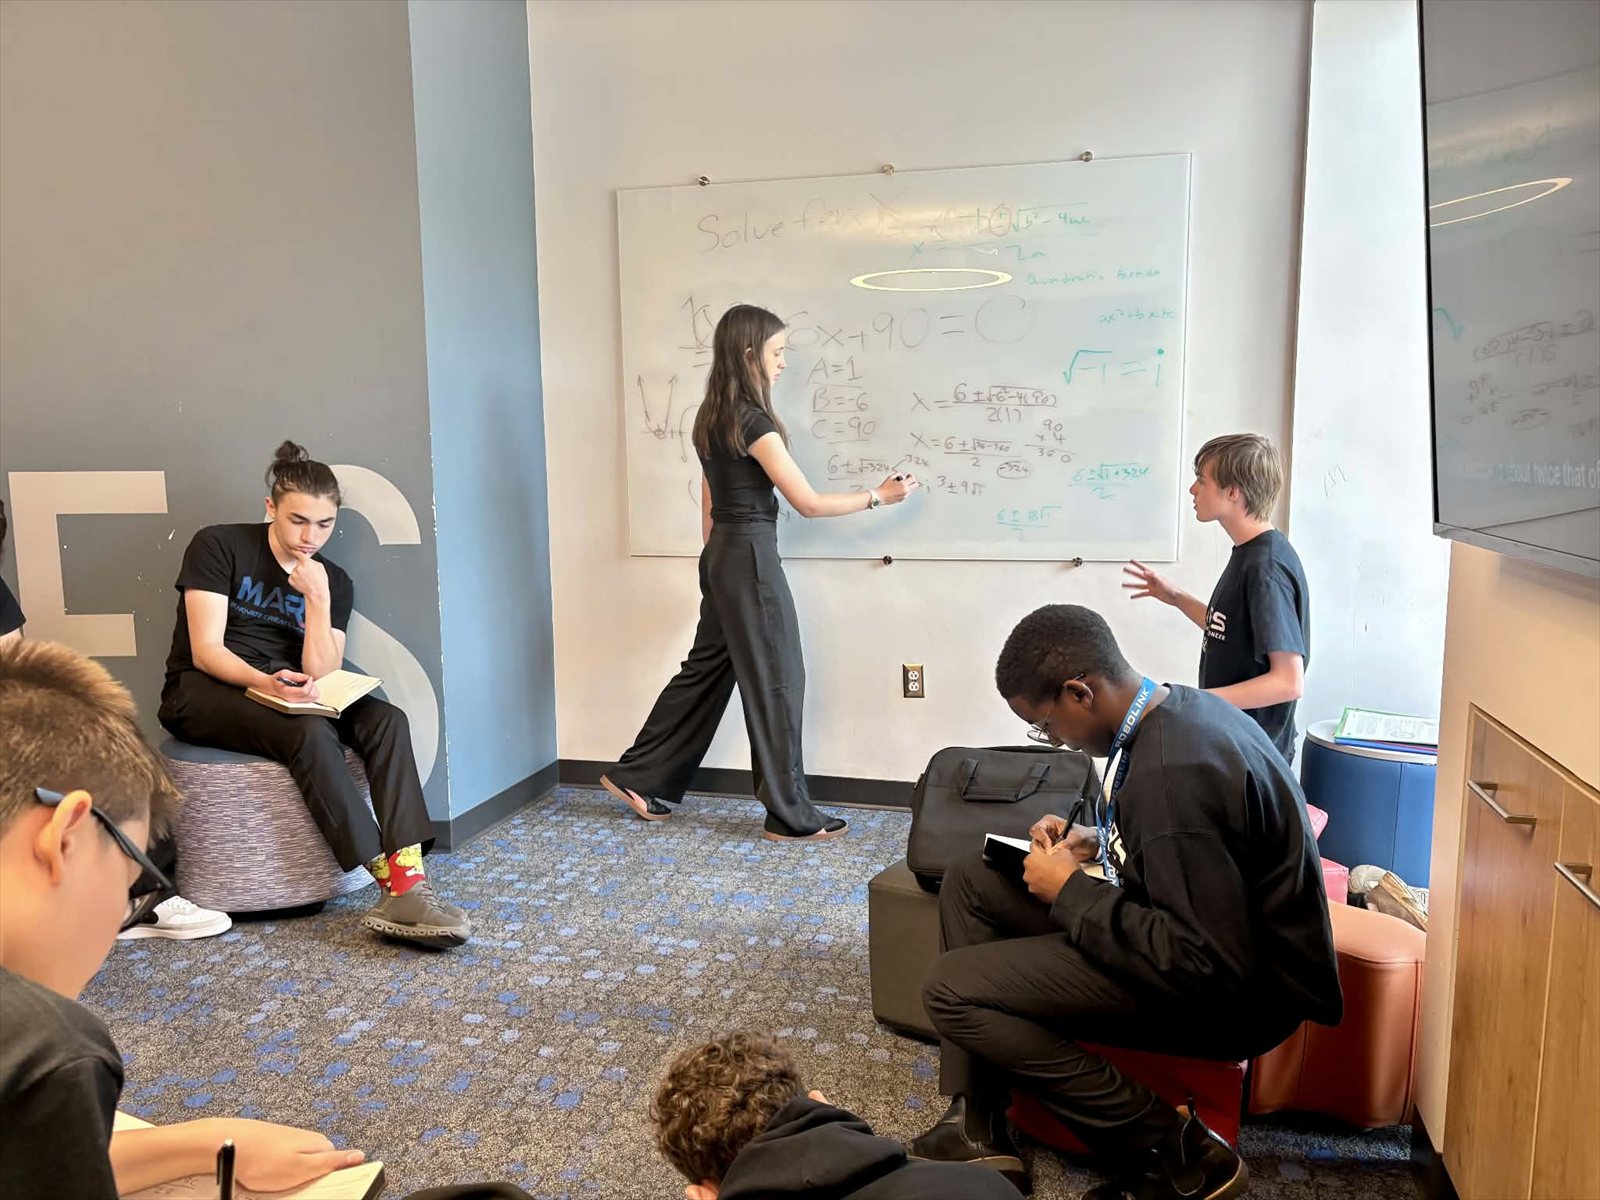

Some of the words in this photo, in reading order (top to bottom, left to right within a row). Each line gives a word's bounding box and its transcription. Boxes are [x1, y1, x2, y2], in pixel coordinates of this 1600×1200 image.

[698, 213, 785, 253] Solve
[1562, 458, 1587, 488] that
[237, 576, 306, 629] MAR
[1114, 687, 1150, 749] ROBOLINK
